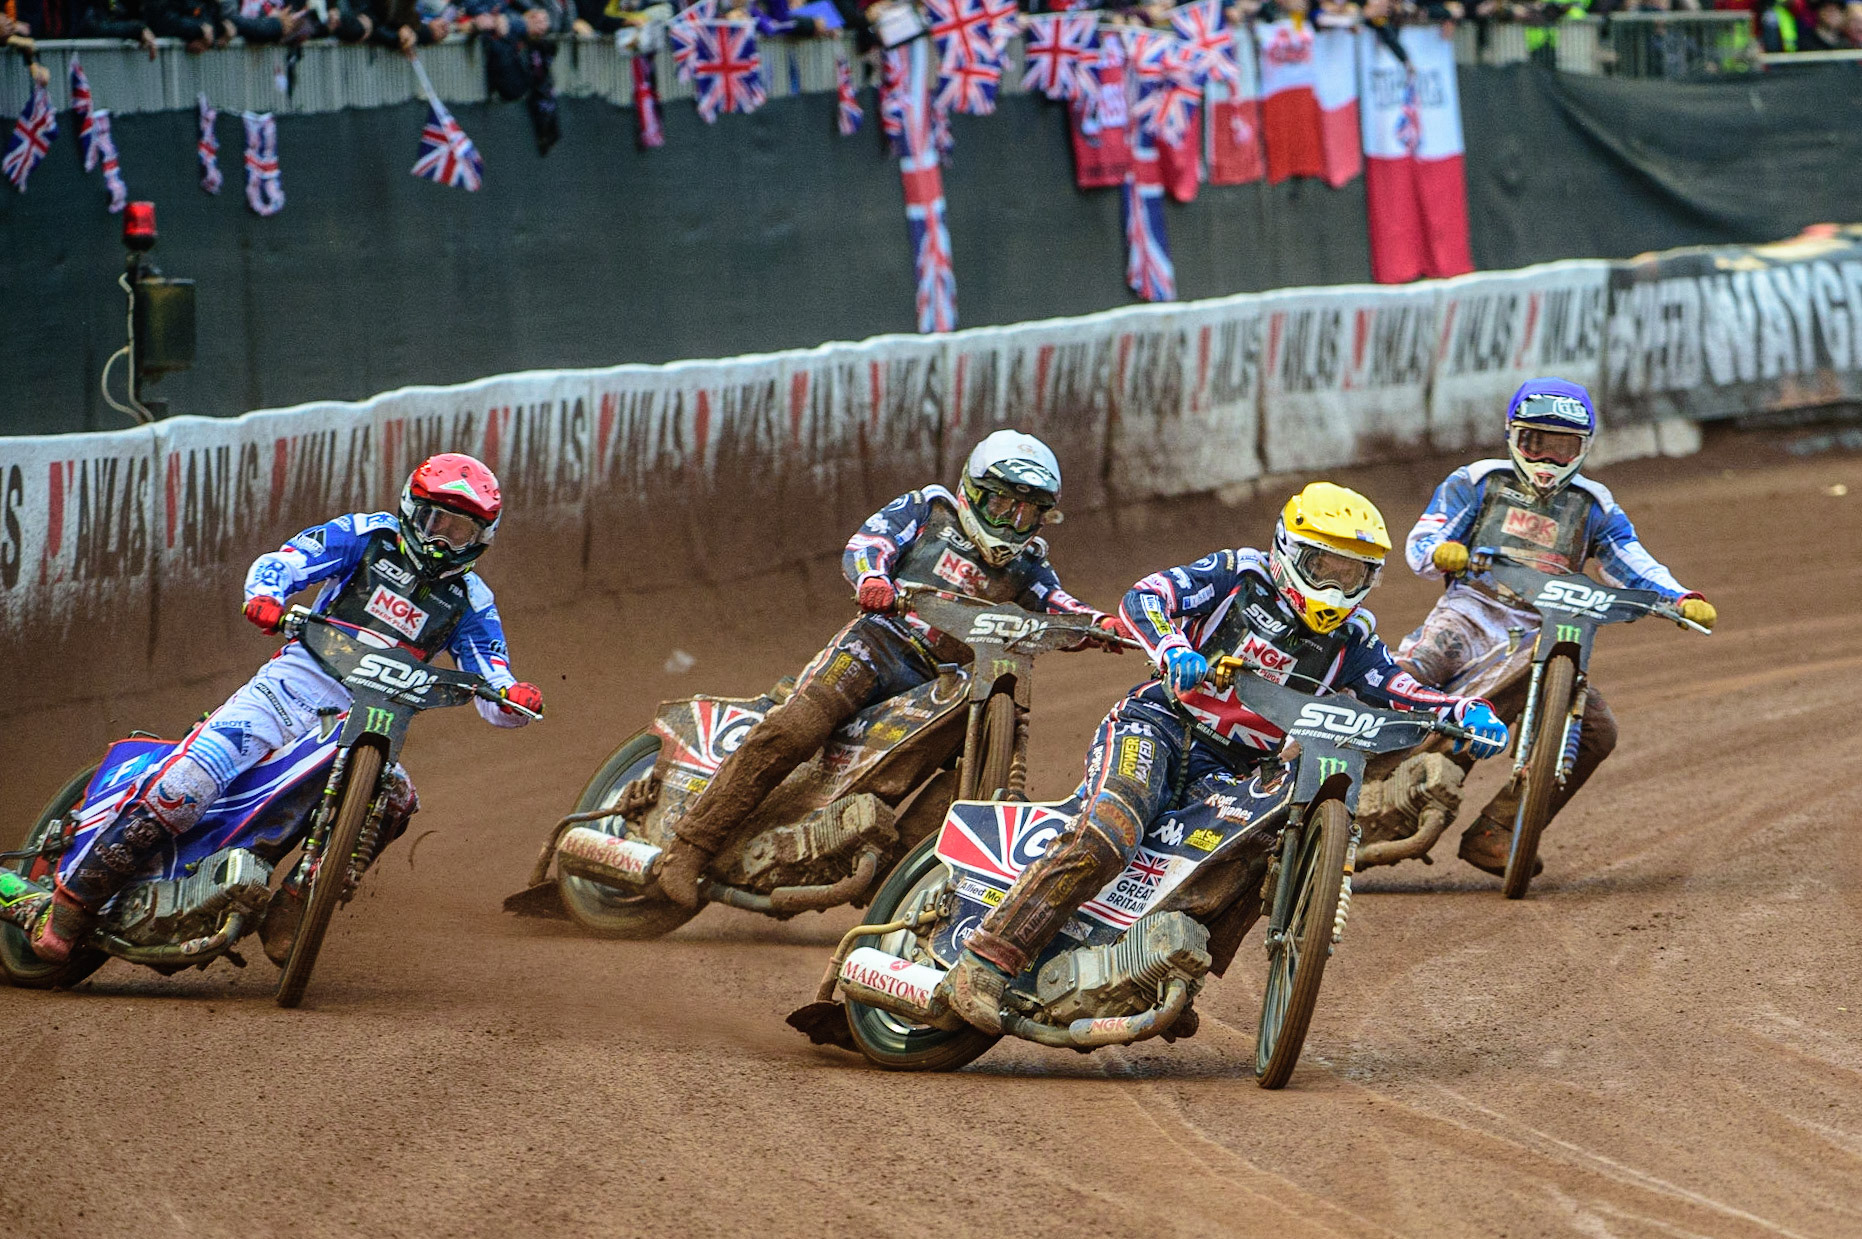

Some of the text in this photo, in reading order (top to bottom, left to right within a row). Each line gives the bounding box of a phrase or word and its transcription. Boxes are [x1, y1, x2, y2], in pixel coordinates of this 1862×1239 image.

[374, 590, 422, 629] NGK
[1243, 637, 1293, 676] NGK
[209, 720, 244, 729] LEROY
[1289, 728, 1302, 737] FIM
[1300, 729, 1336, 741] SPEEDWAY
[1123, 736, 1140, 778] POWER
[1135, 739, 1155, 785] MAXED
[1204, 793, 1238, 809] Roger
[960, 882, 986, 898] Allied
[1116, 879, 1156, 901] GREAT
[1106, 892, 1148, 914] BRITAIN
[1090, 1016, 1131, 1033] NGK
